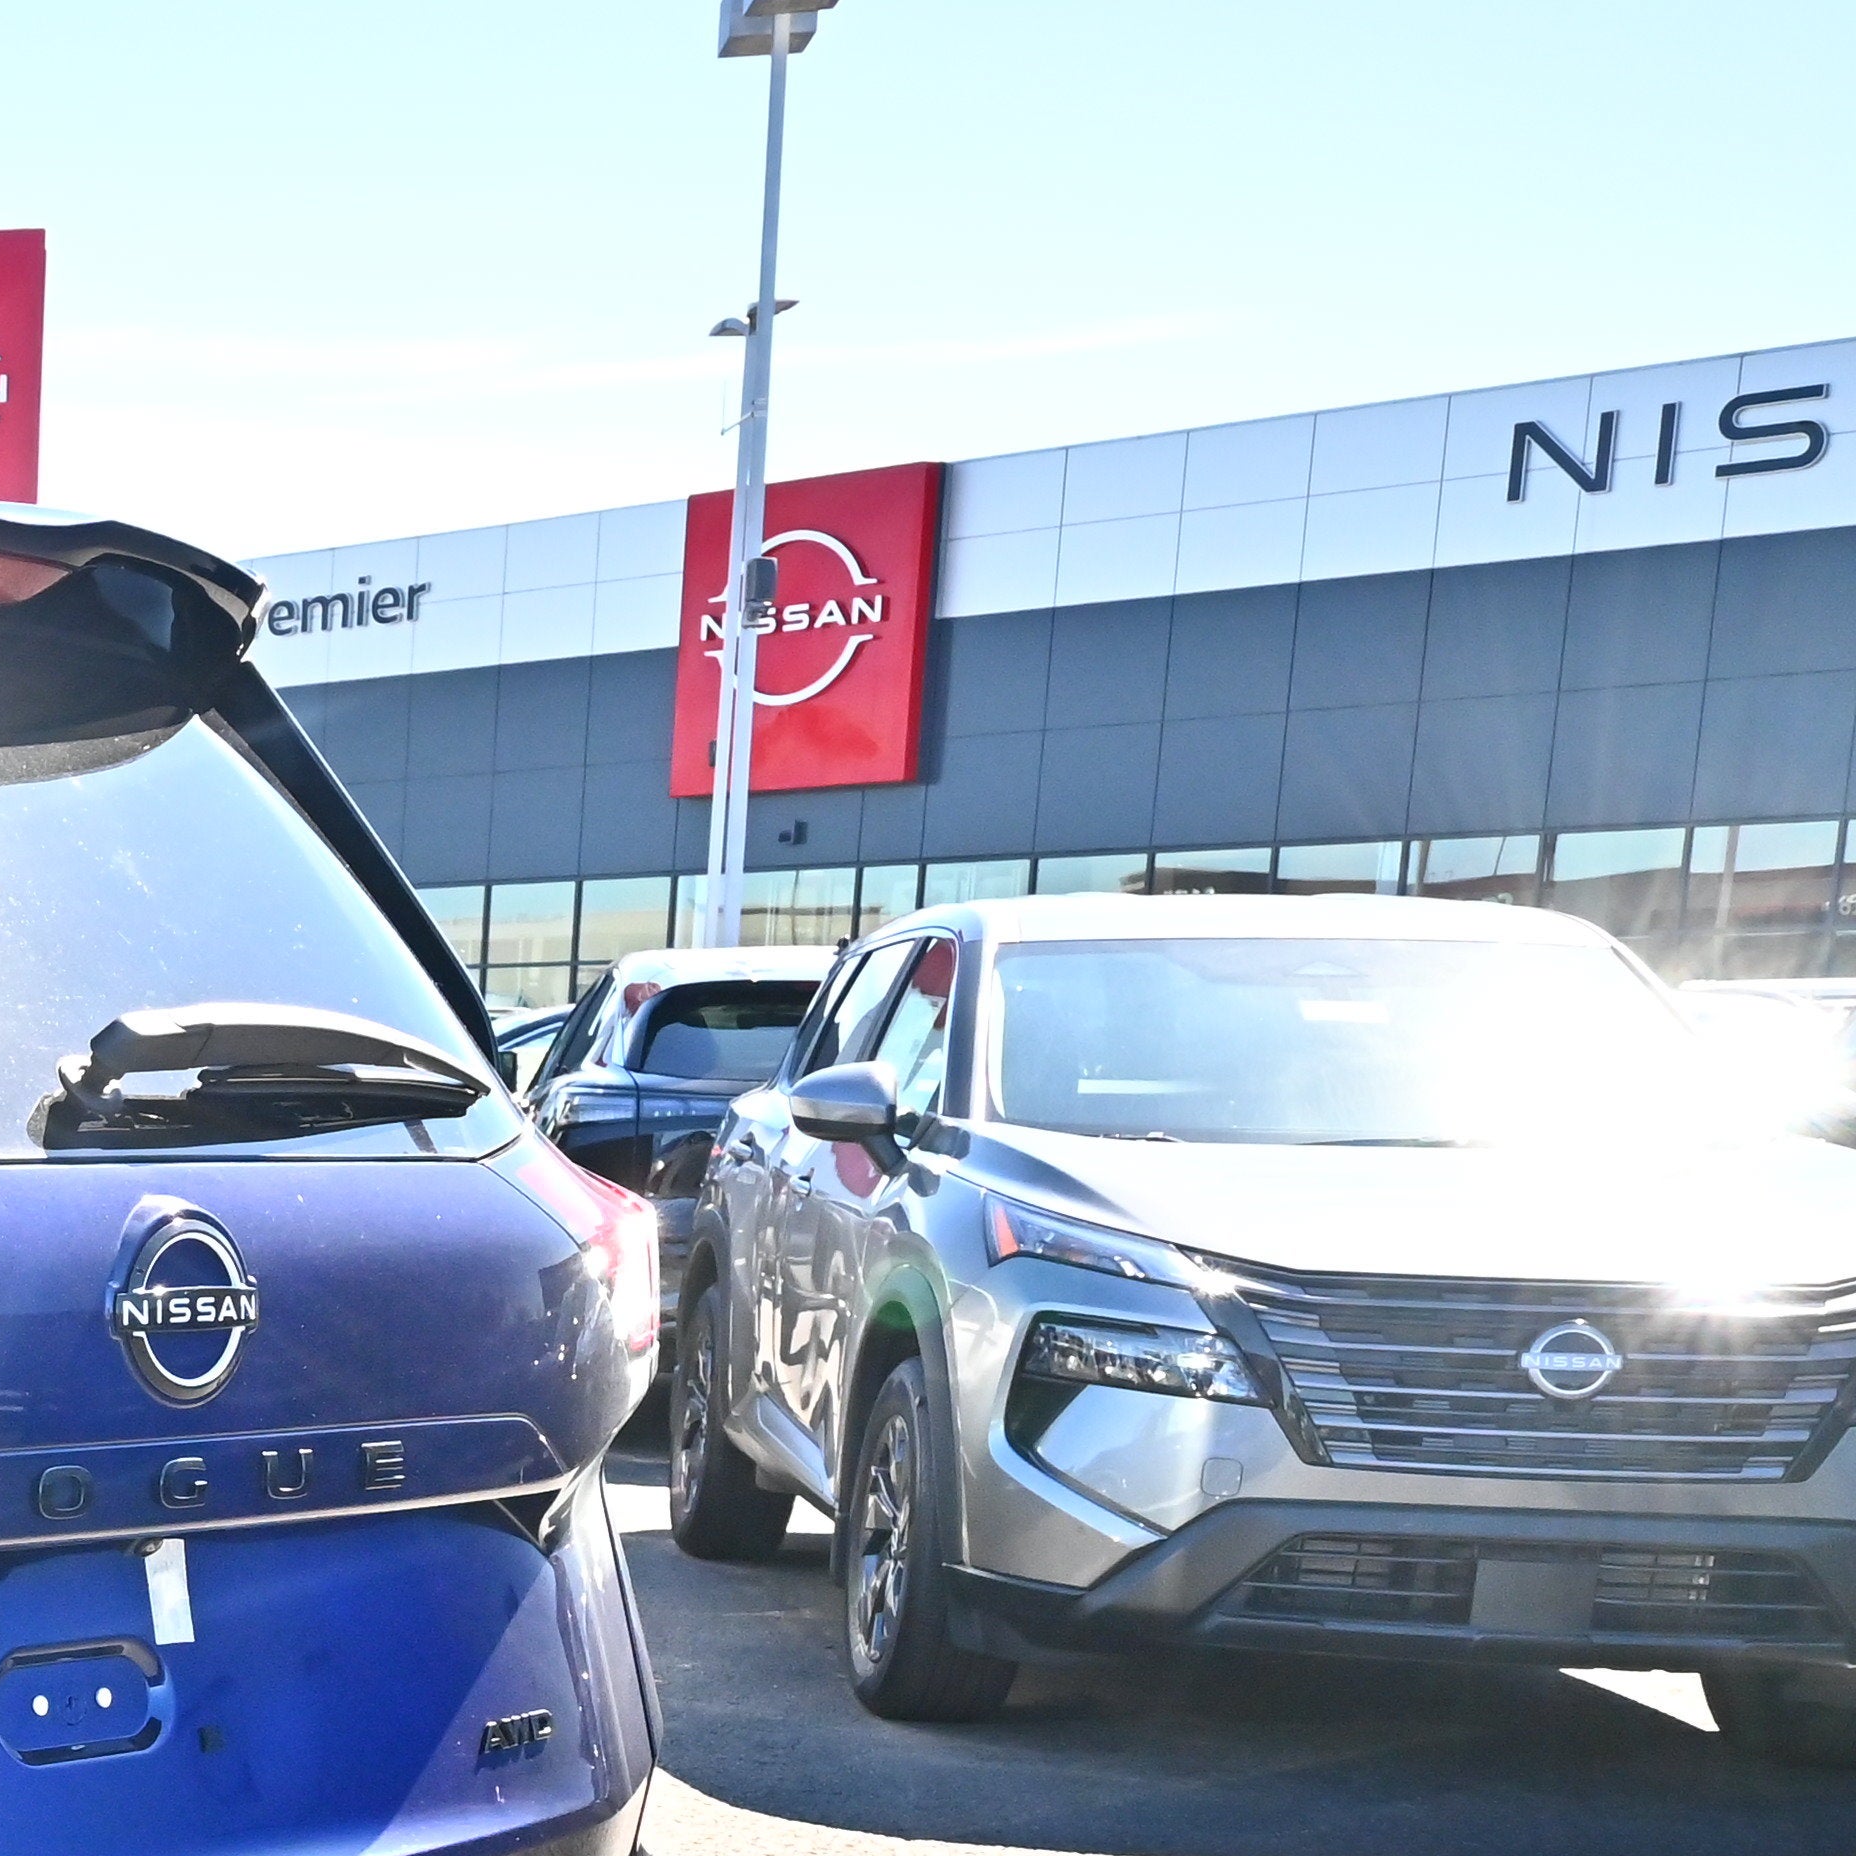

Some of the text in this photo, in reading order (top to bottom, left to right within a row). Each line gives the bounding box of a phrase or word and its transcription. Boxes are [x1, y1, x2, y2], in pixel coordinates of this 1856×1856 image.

[1506, 382, 1831, 503] NIS
[700, 594, 884, 642] NSSAN
[121, 1294, 258, 1326] NISSAN
[1522, 1354, 1622, 1369] NISSAN
